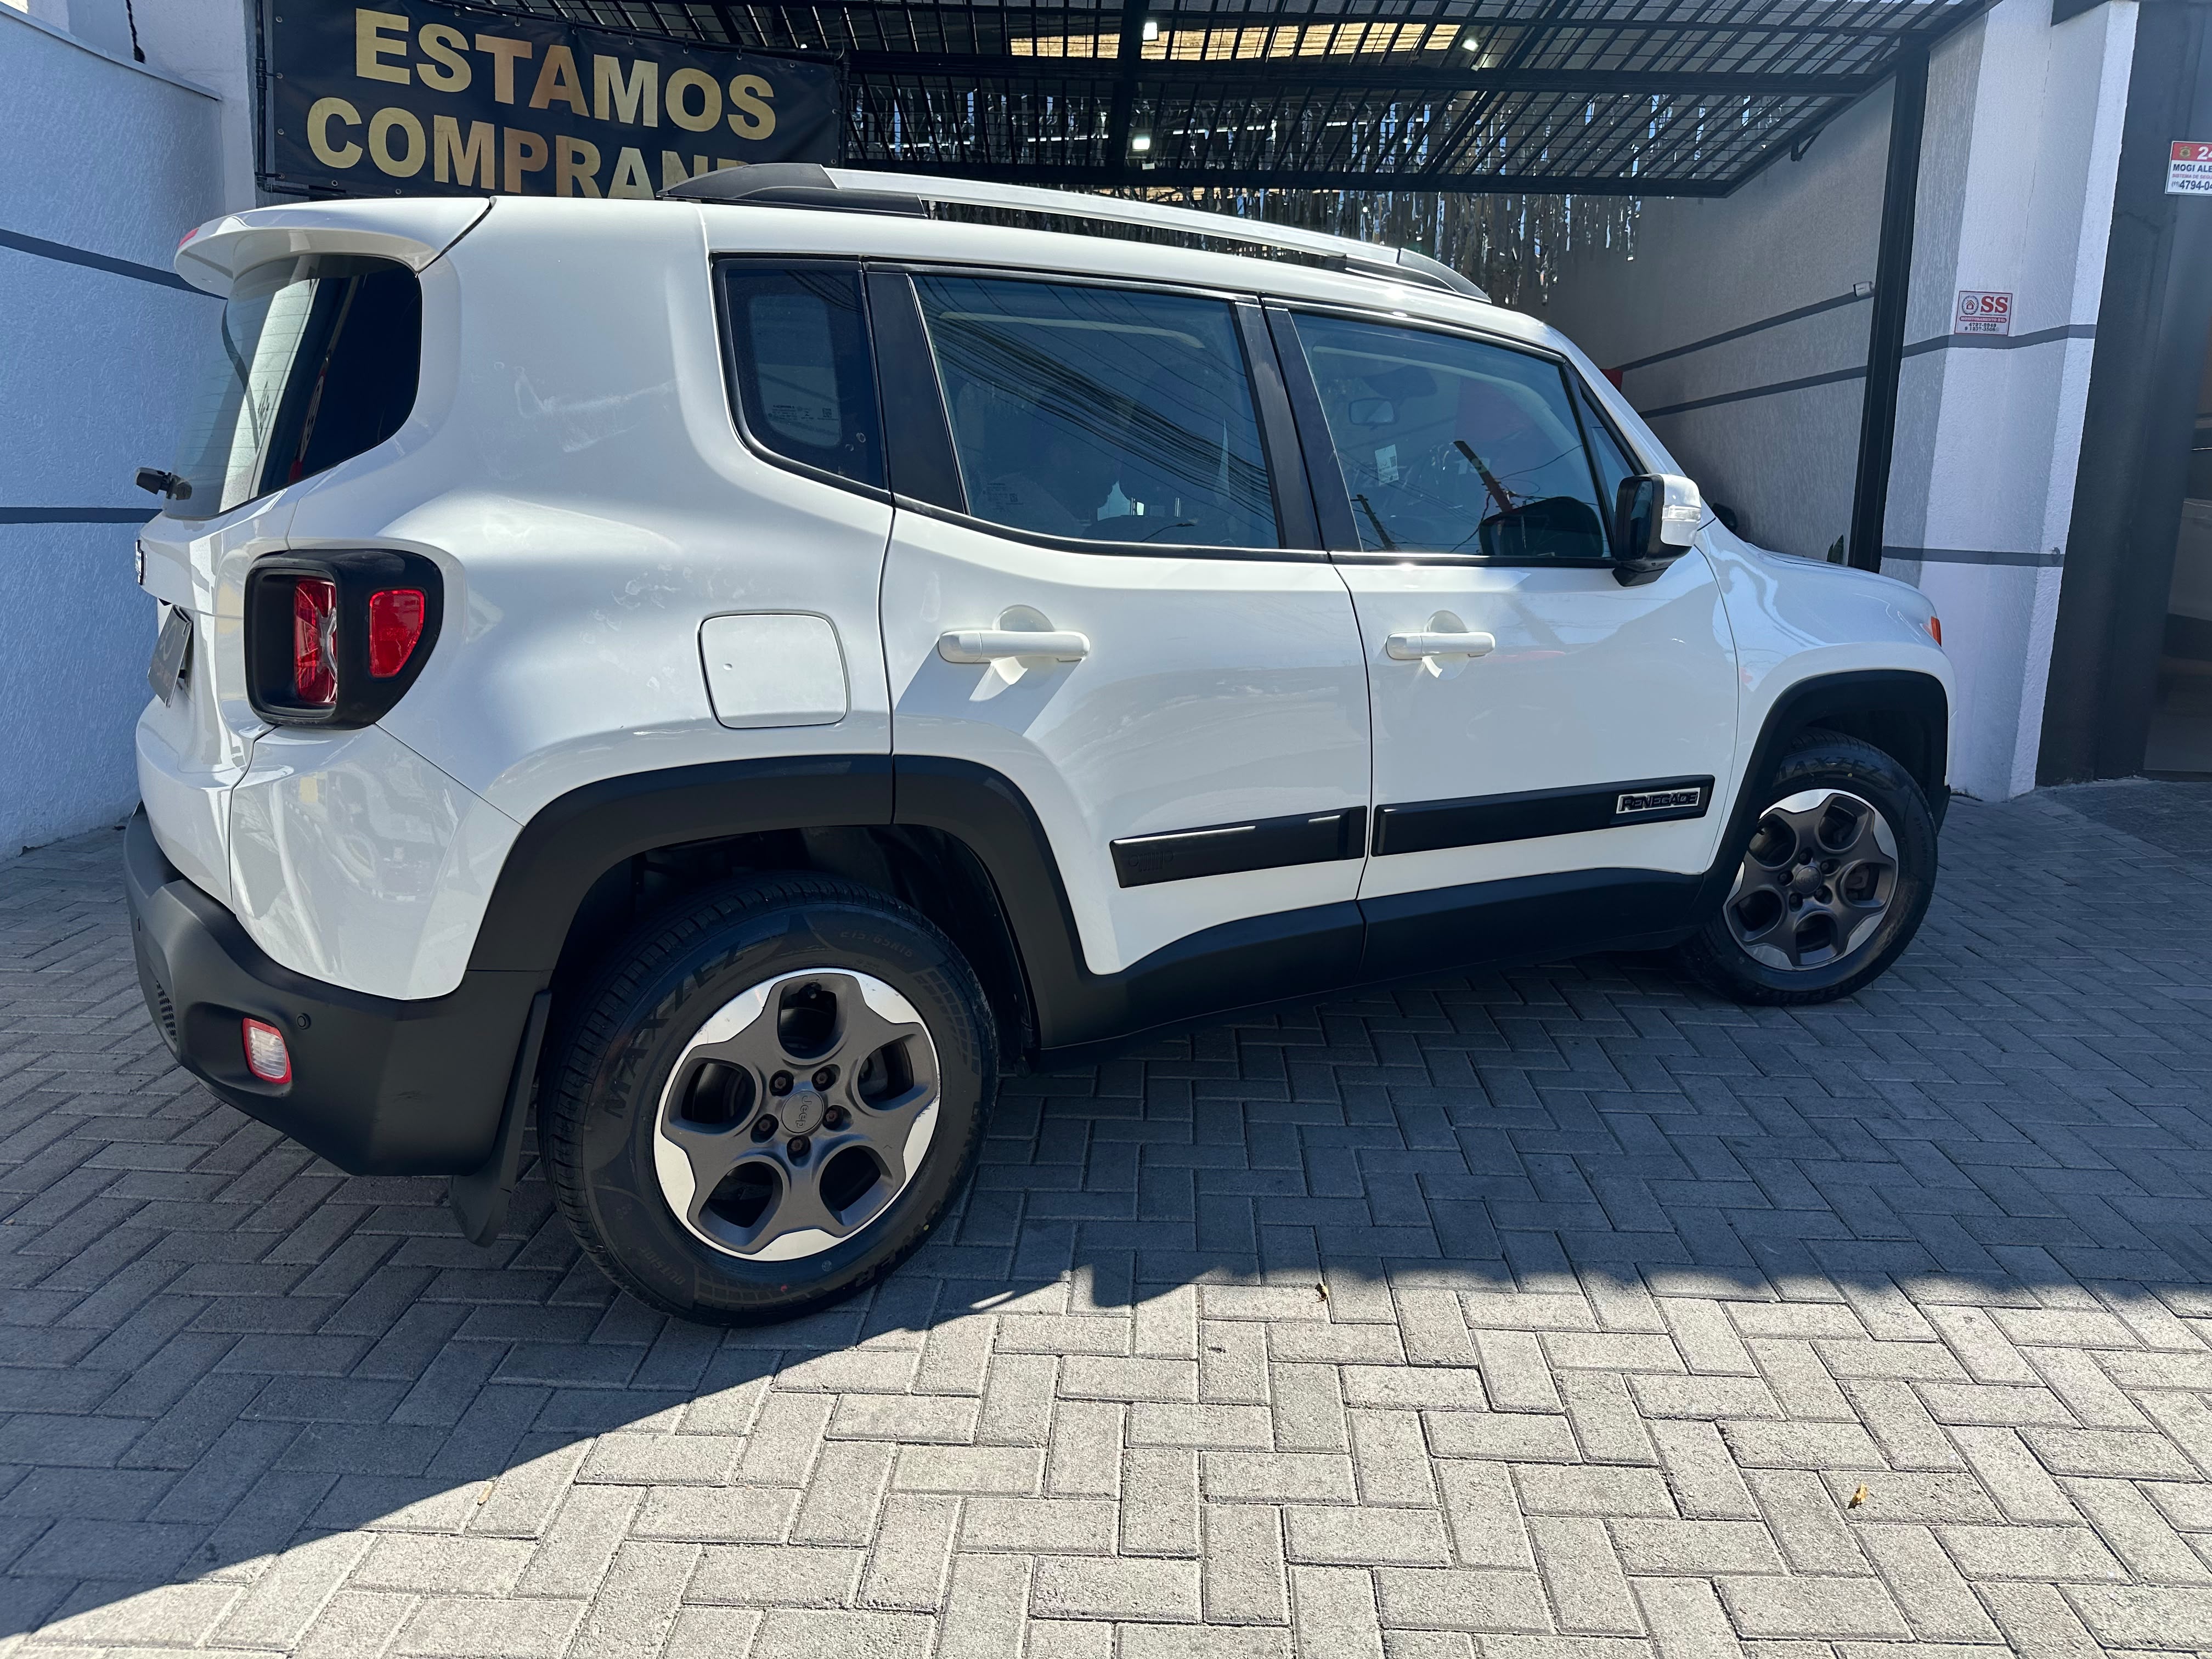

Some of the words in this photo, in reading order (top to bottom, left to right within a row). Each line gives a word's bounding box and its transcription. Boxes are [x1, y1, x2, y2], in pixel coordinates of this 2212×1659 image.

[355, 7, 776, 142] ESTAMOS
[307, 96, 750, 199] COMPRAN
[2172, 163, 2196, 172] MOGI
[2197, 165, 2212, 173] ALE
[1980, 296, 2008, 313] SS
[1453, 457, 1491, 473] 19
[1619, 791, 1699, 812] RENEGADE
[795, 1095, 812, 1128] Jeep
